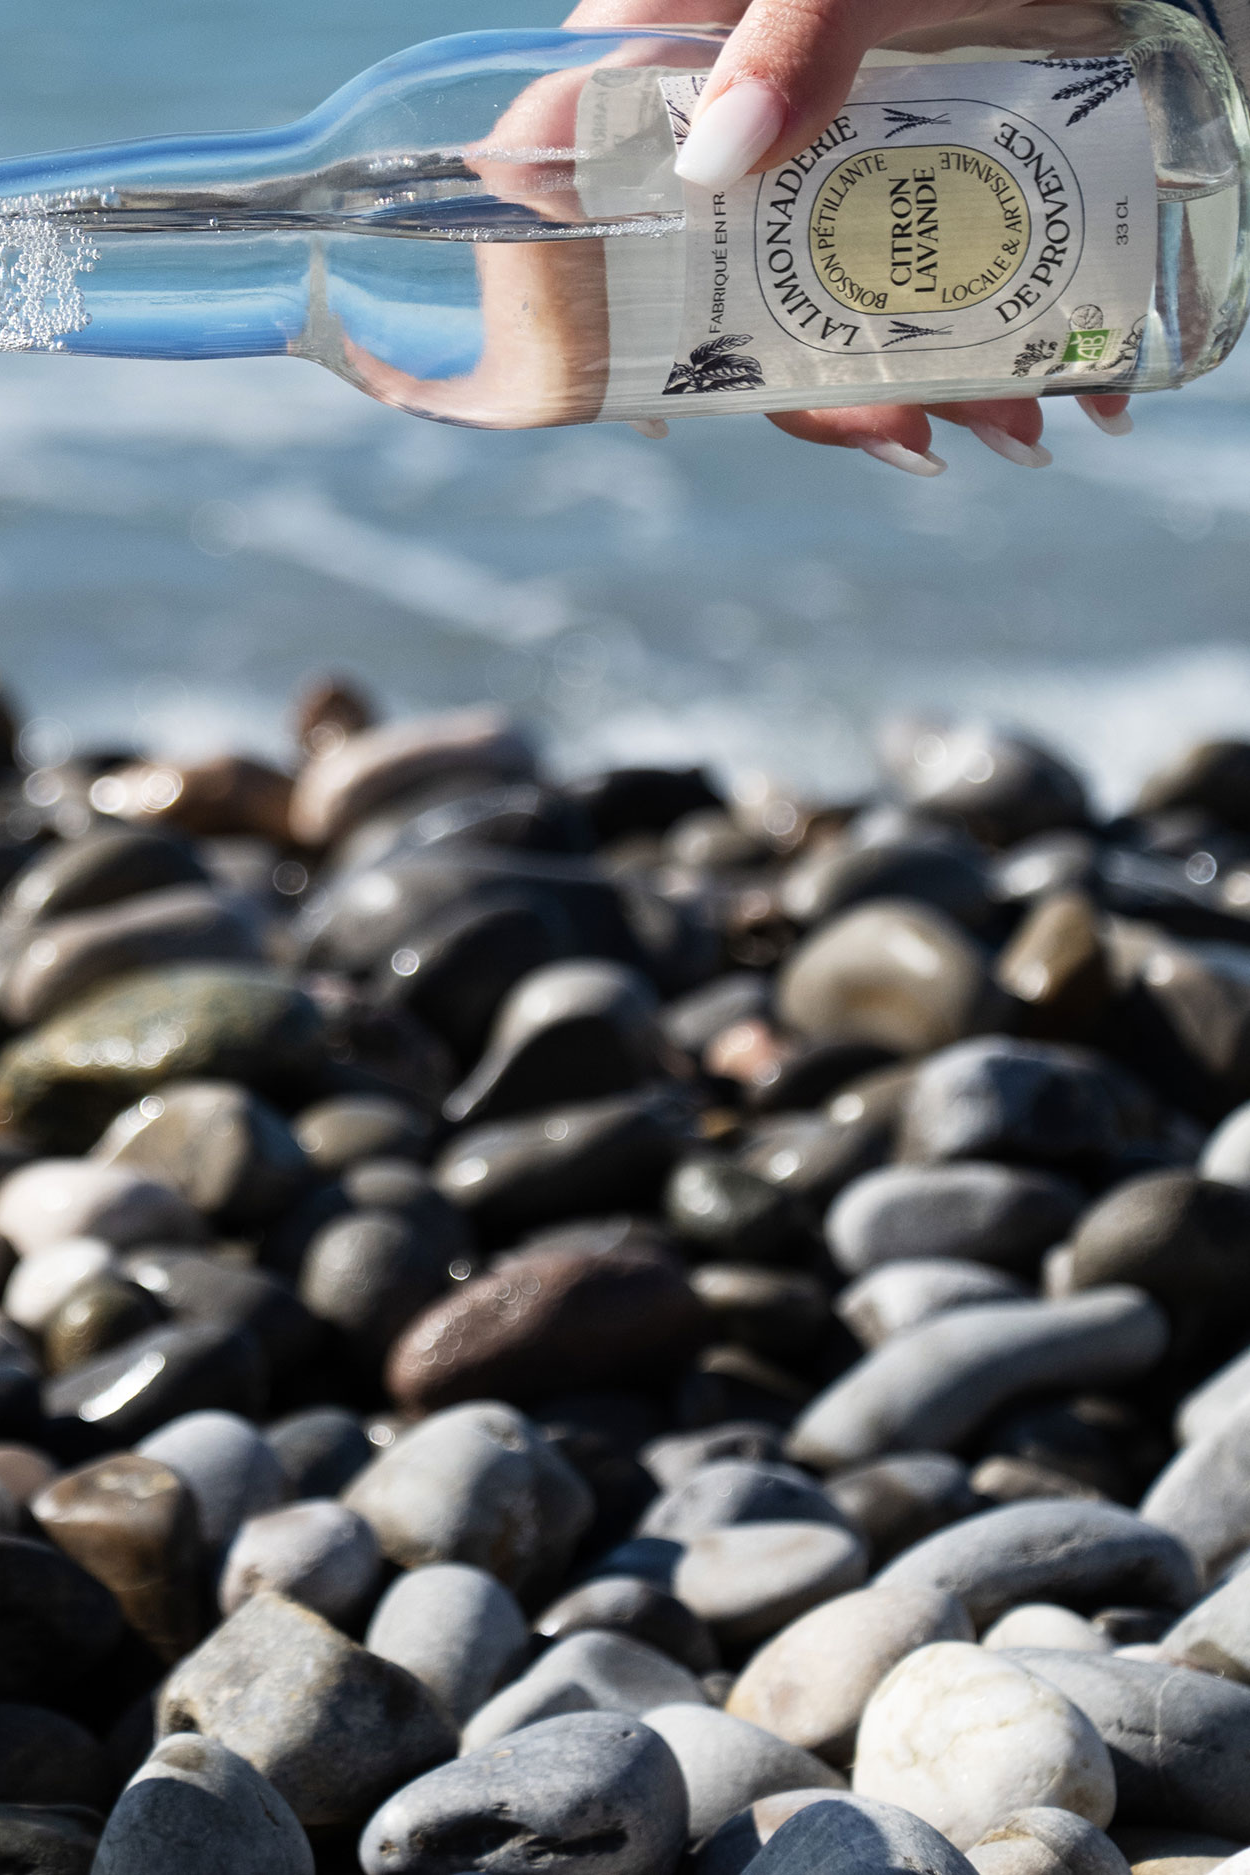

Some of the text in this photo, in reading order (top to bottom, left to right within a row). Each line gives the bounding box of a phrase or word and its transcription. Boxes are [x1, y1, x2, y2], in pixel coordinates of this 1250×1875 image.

[709, 191, 728, 334] FABRIQUÉ EN FR
[766, 116, 860, 347] LA LIMONADERIE
[812, 153, 889, 309] BOISSON PÉTILLANTE
[888, 178, 913, 287] CITRON
[913, 166, 939, 293] LAVANDE
[938, 151, 1023, 304] LOCALE & ARTISANALE
[993, 122, 1071, 323] DE PROVENCE
[1115, 196, 1129, 246] 33 CL
[1077, 335, 1106, 360] AB
